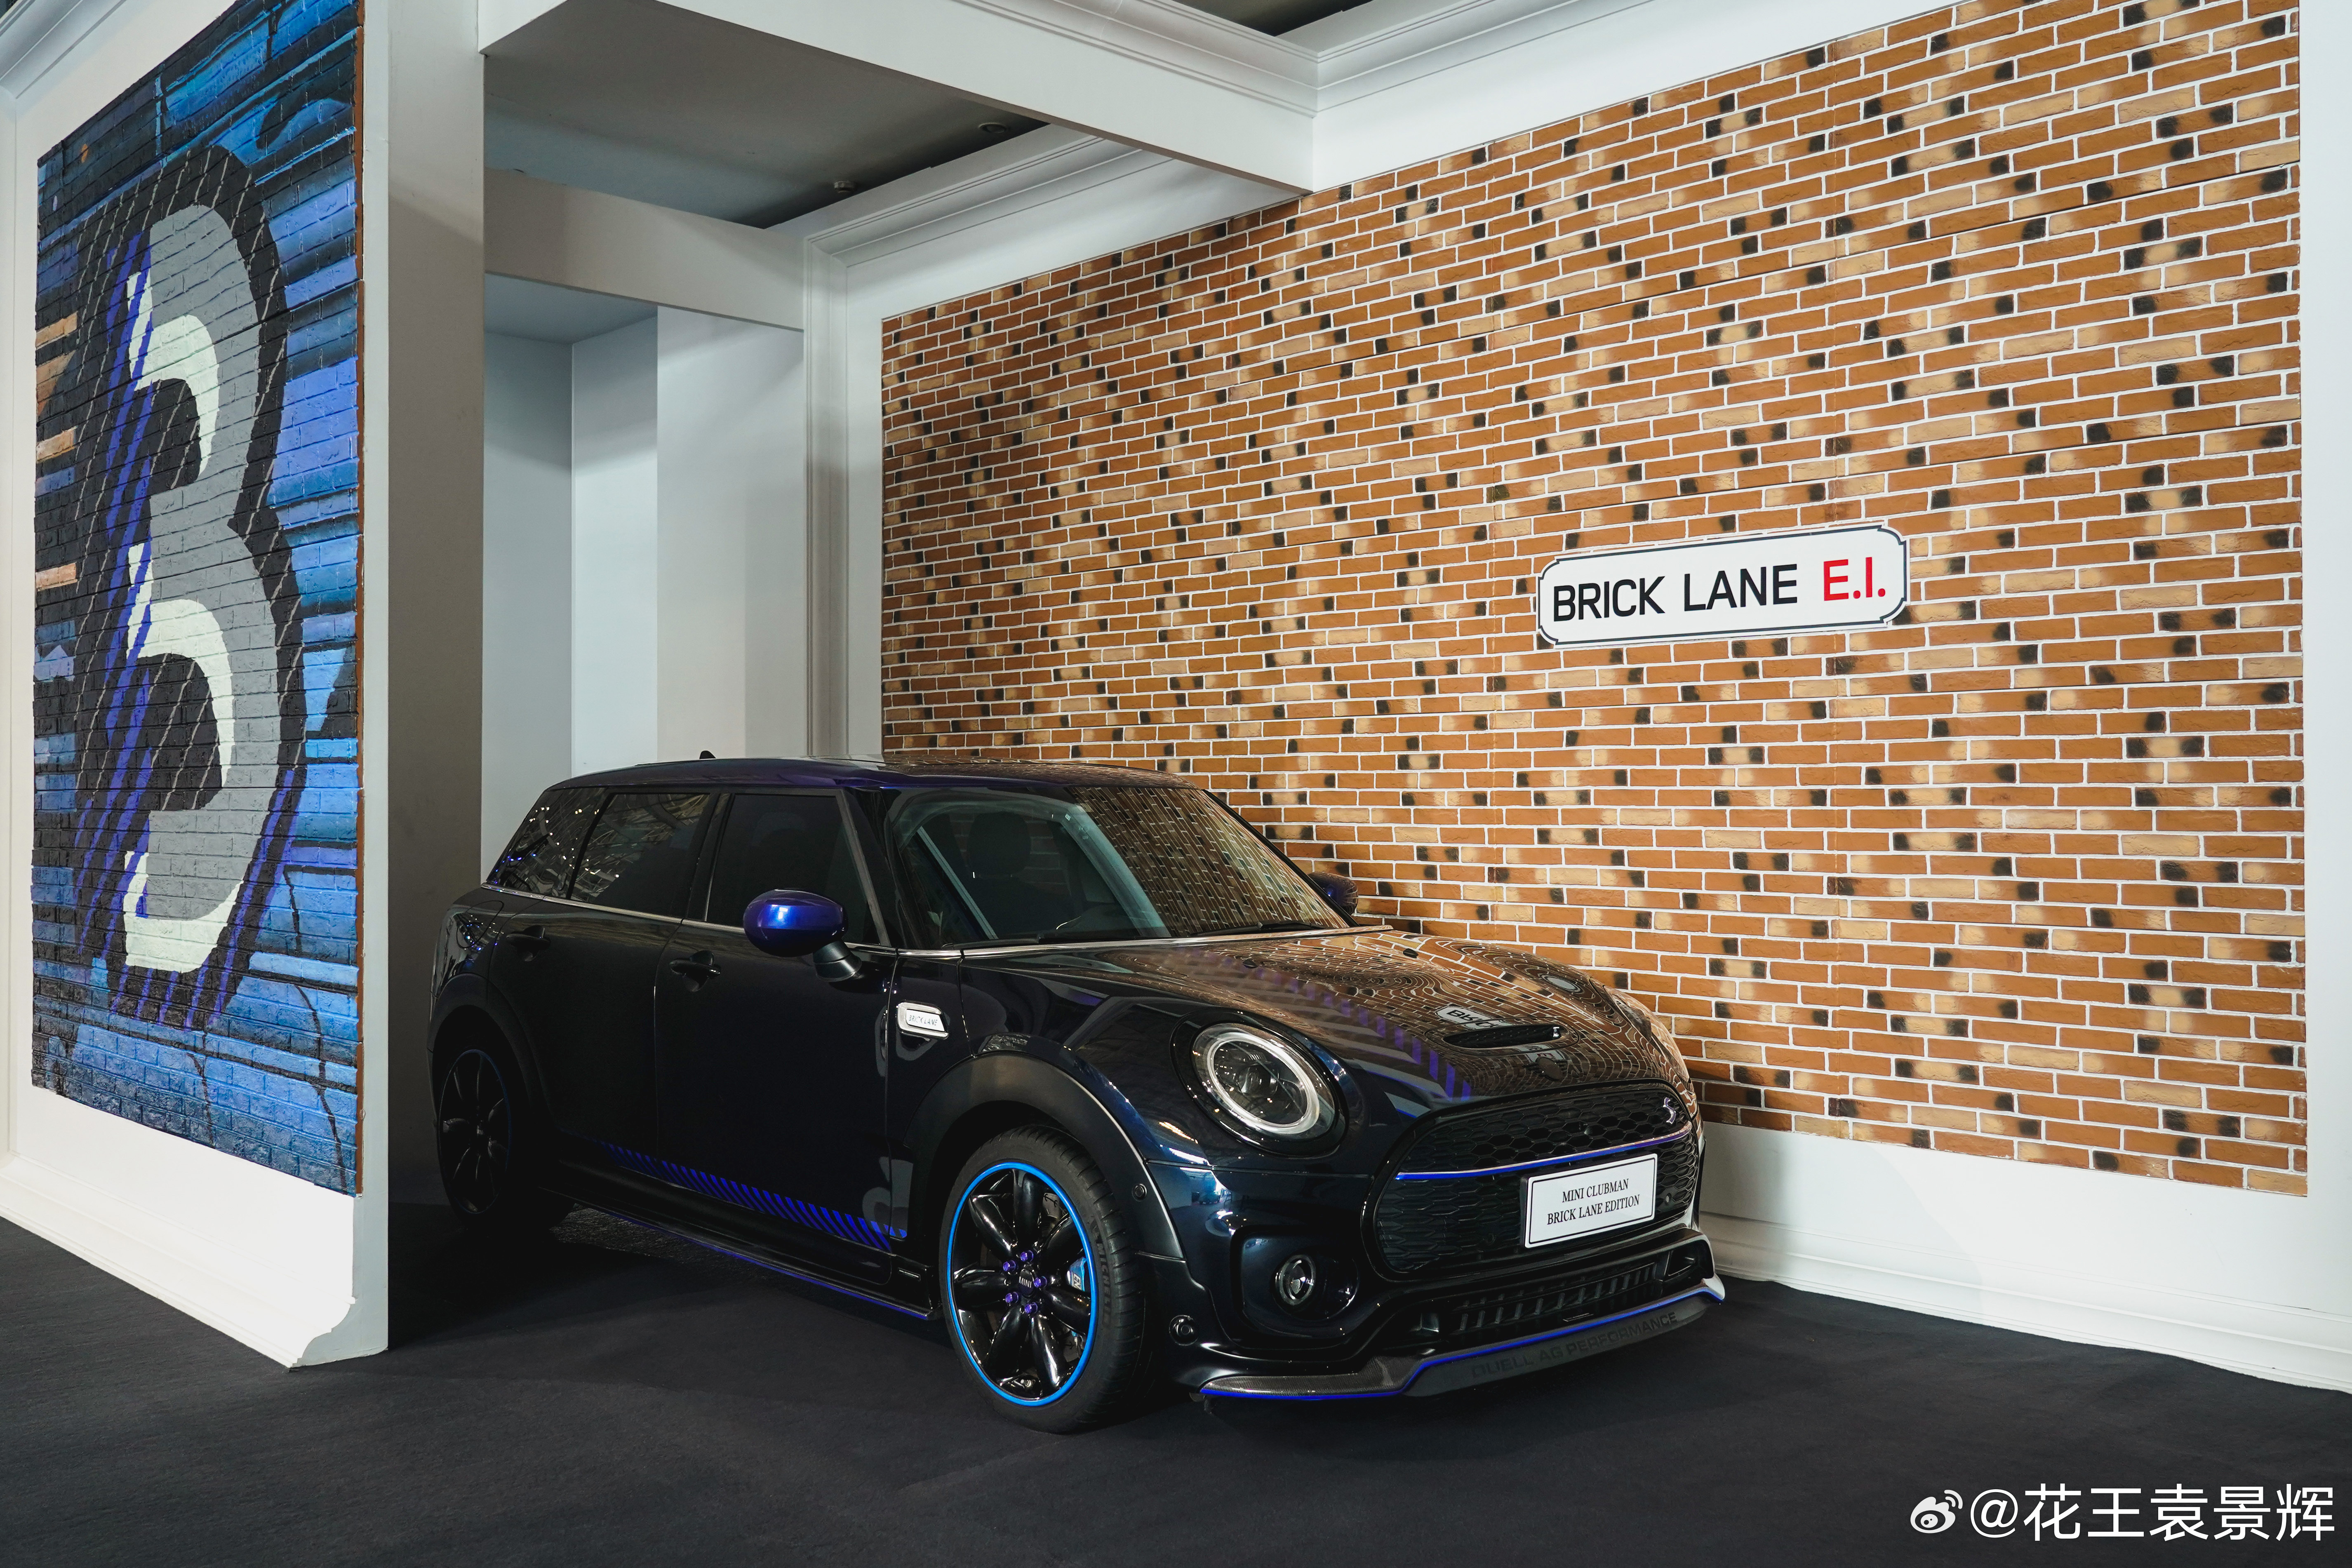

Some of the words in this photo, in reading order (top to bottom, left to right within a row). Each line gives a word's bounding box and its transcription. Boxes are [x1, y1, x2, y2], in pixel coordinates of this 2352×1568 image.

[1553, 576, 1665, 622] BRICK
[1684, 564, 1797, 612] LANE
[909, 1015, 923, 1023] BRICK
[1562, 1188, 1584, 1203] MINI
[1586, 1178, 1629, 1197] CLUBMAN
[1547, 1208, 1576, 1225] BRICK
[1579, 1203, 1603, 1218] LANE
[1605, 1194, 1640, 1213] EDITION
[1019, 1276, 1032, 1288] MINI
[1539, 1346, 1564, 1361] AG
[1566, 1312, 1678, 1356] PERFORMANCE
